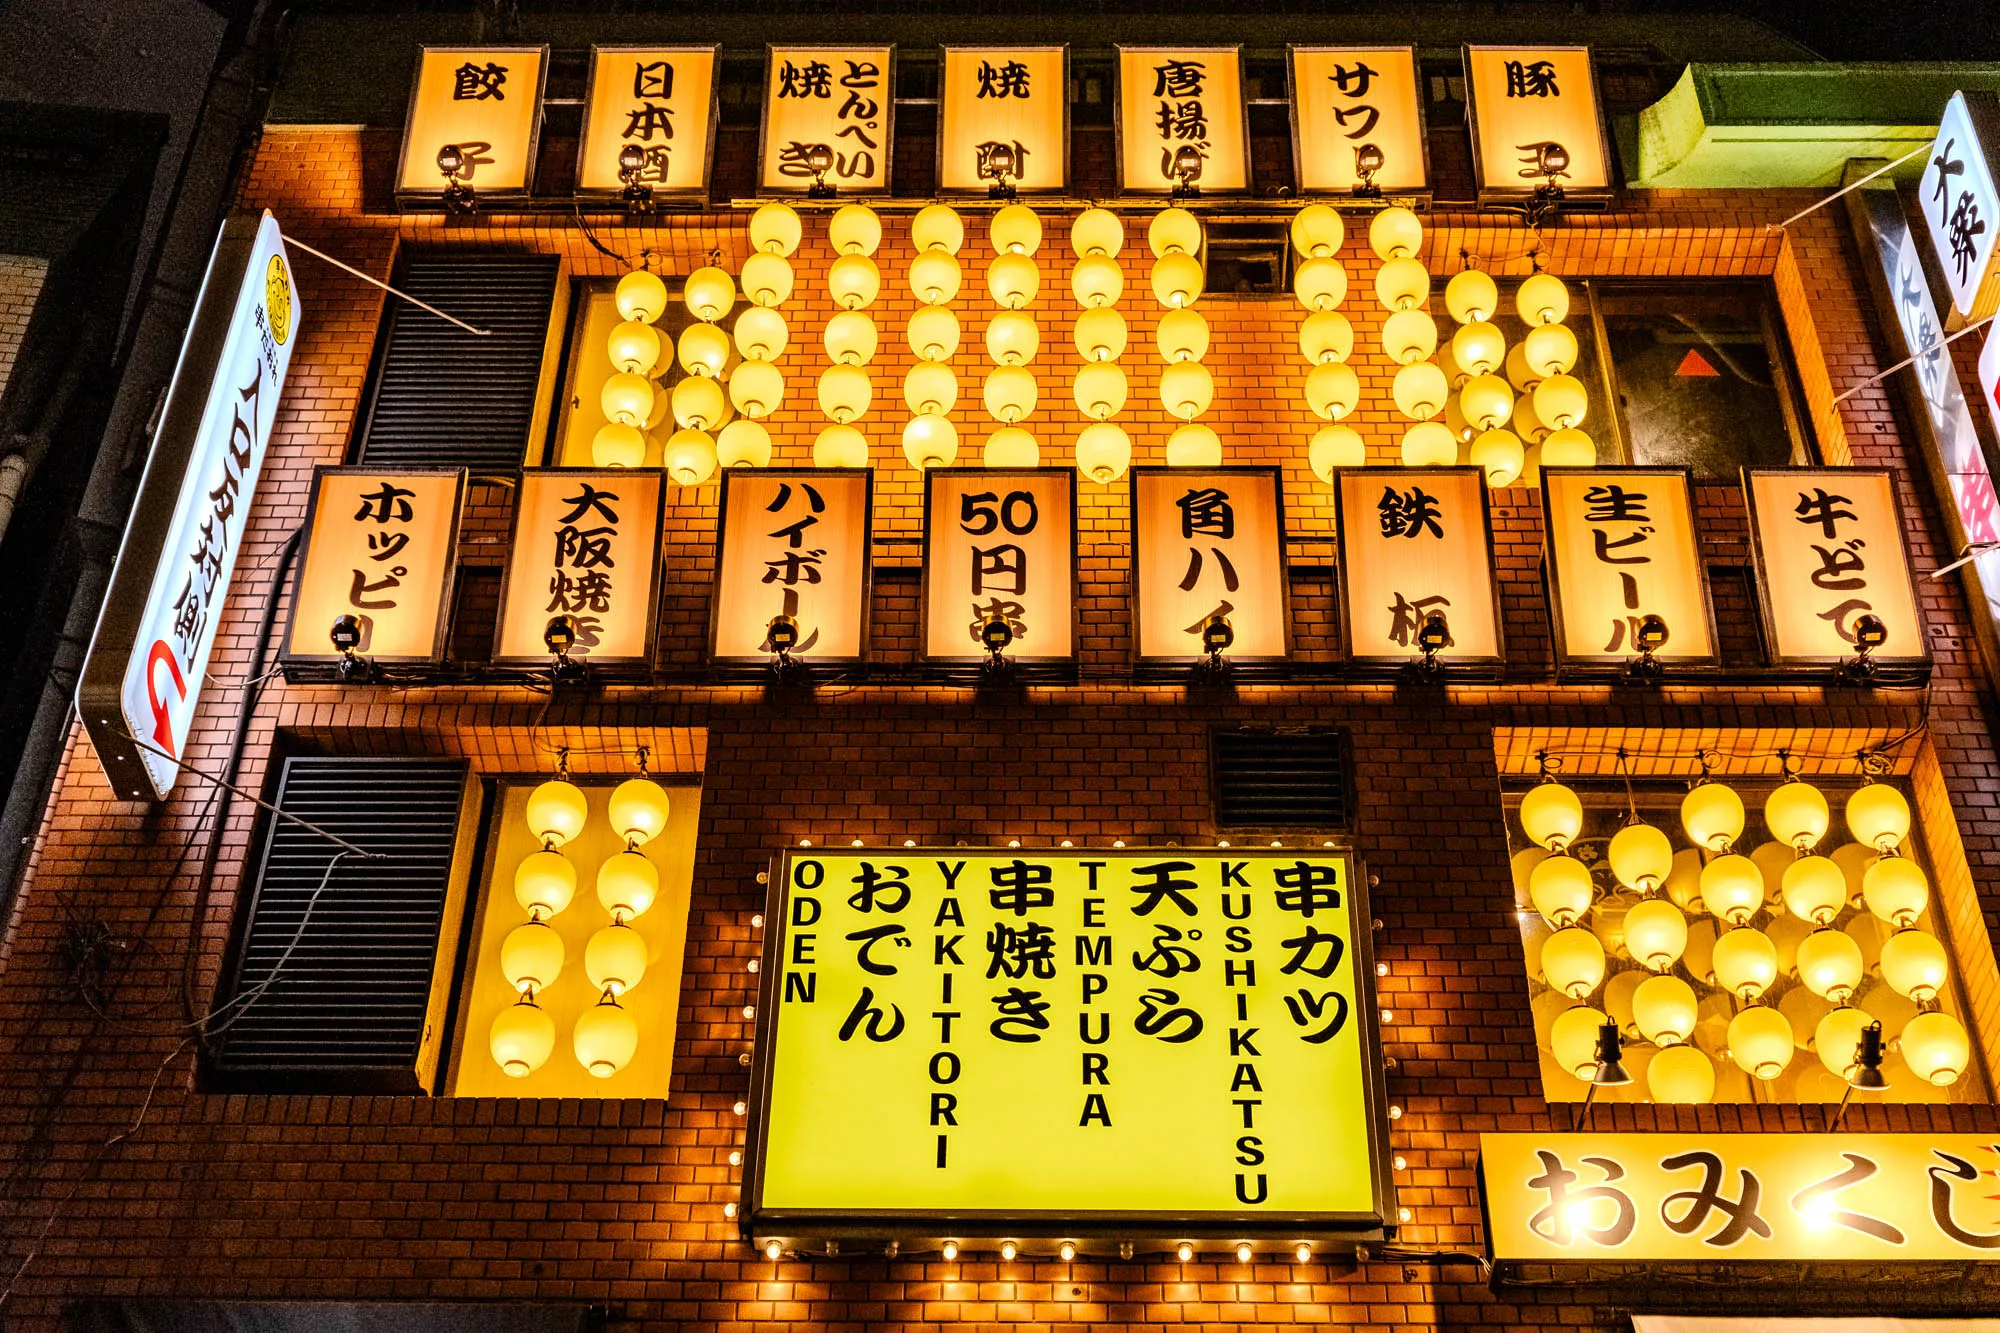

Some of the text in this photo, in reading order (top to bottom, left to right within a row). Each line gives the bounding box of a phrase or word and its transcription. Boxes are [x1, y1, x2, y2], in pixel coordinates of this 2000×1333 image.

[446, 62, 510, 180] 餃子
[618, 61, 676, 182] 日本酒
[836, 60, 880, 178] とんぺい
[173, 358, 263, 674] 入口反対側
[959, 491, 1038, 642] 50円串
[1584, 485, 1656, 652] 生ビール
[1795, 487, 1872, 642] 牛どて
[785, 860, 824, 1003] ODEN
[839, 861, 912, 1042] おでん
[928, 861, 966, 1169] YAKITORI
[986, 860, 1056, 1043] 串焼き
[1075, 861, 1112, 1127] TEMPURA
[1131, 861, 1204, 1043] 天ぷら
[1274, 860, 1348, 1043] 串カツ
[1221, 861, 1268, 1205] KUSHIKATSU
